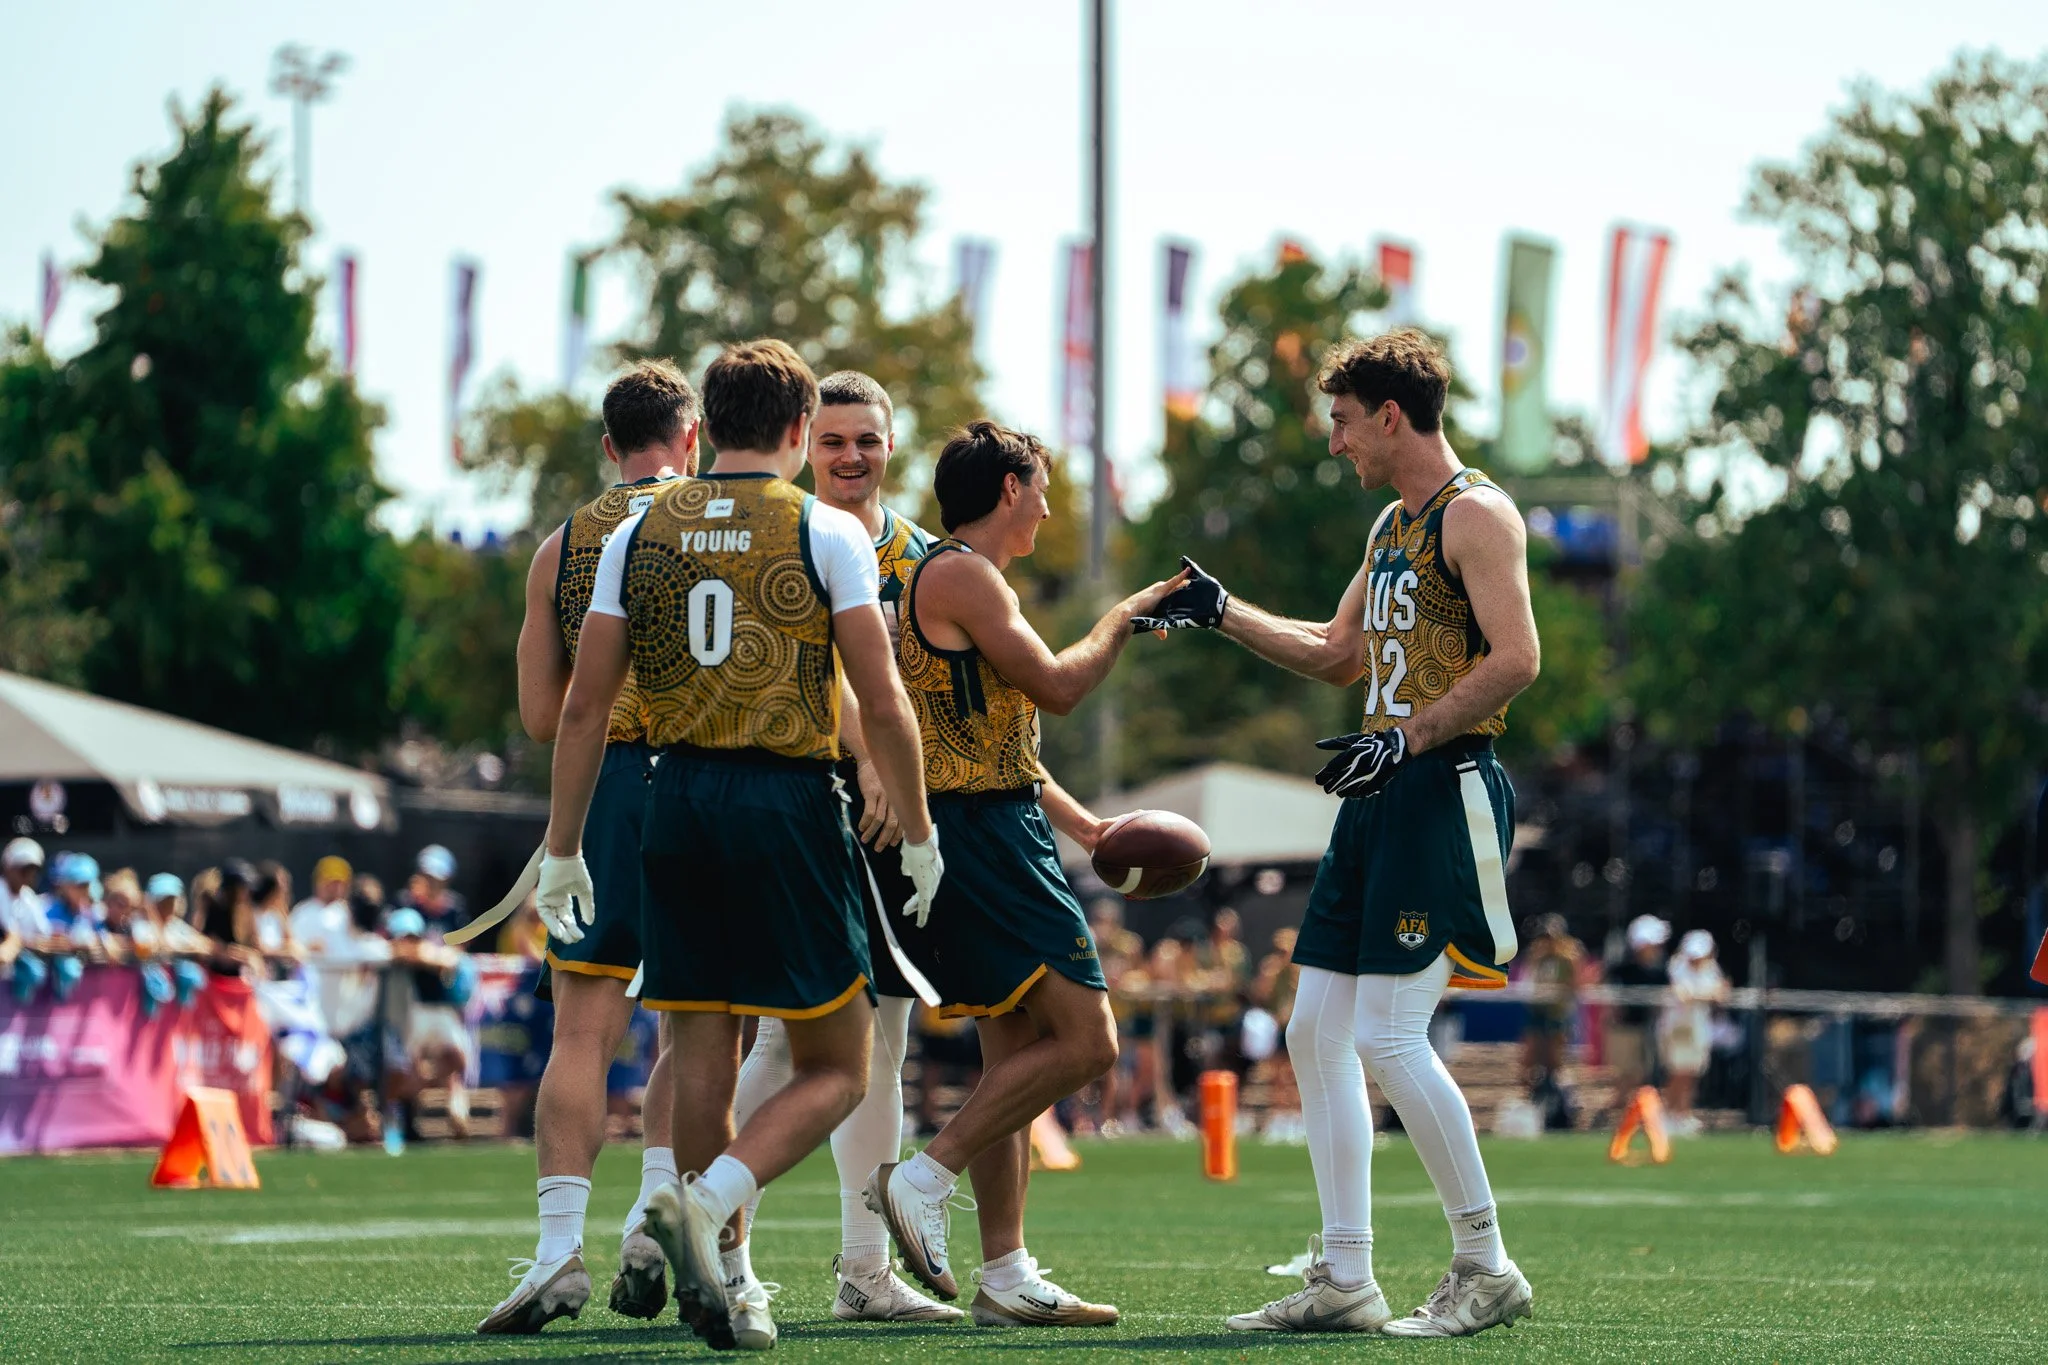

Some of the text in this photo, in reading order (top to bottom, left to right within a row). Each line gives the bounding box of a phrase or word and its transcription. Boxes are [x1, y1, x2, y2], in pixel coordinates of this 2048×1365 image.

[680, 529, 752, 553] YOUNG
[688, 579, 734, 666] 0
[1396, 918, 1428, 936] AFA
[1471, 1218, 1496, 1231] VAL
[841, 1282, 868, 1312] NIKE
